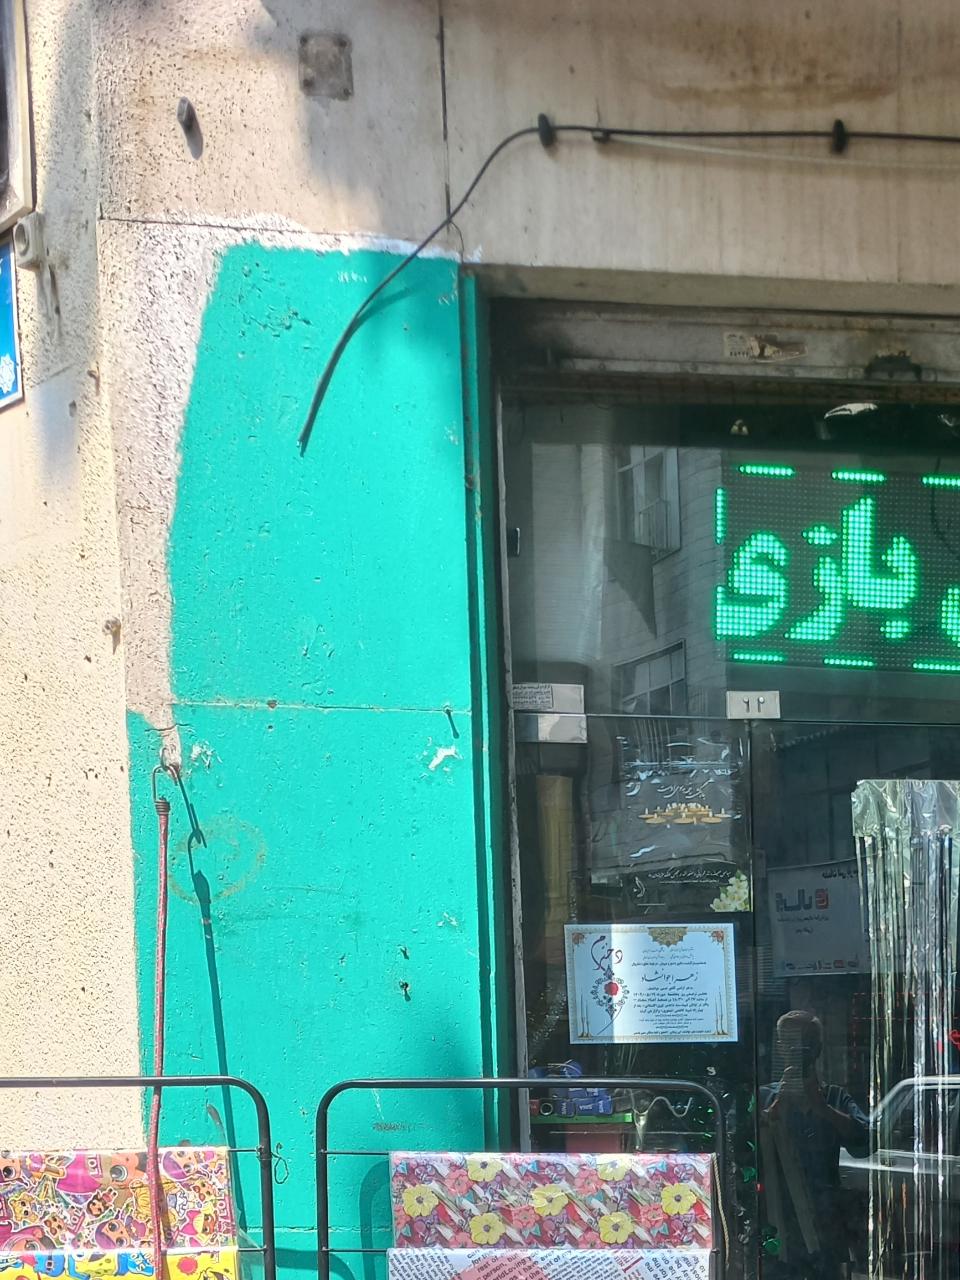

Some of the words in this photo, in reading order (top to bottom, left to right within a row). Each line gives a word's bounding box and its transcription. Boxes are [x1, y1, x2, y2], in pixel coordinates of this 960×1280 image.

[716, 496, 919, 642] بازی
[644, 1261, 654, 1273] me
[529, 1270, 541, 1280] the
[659, 1268, 669, 1279] for
